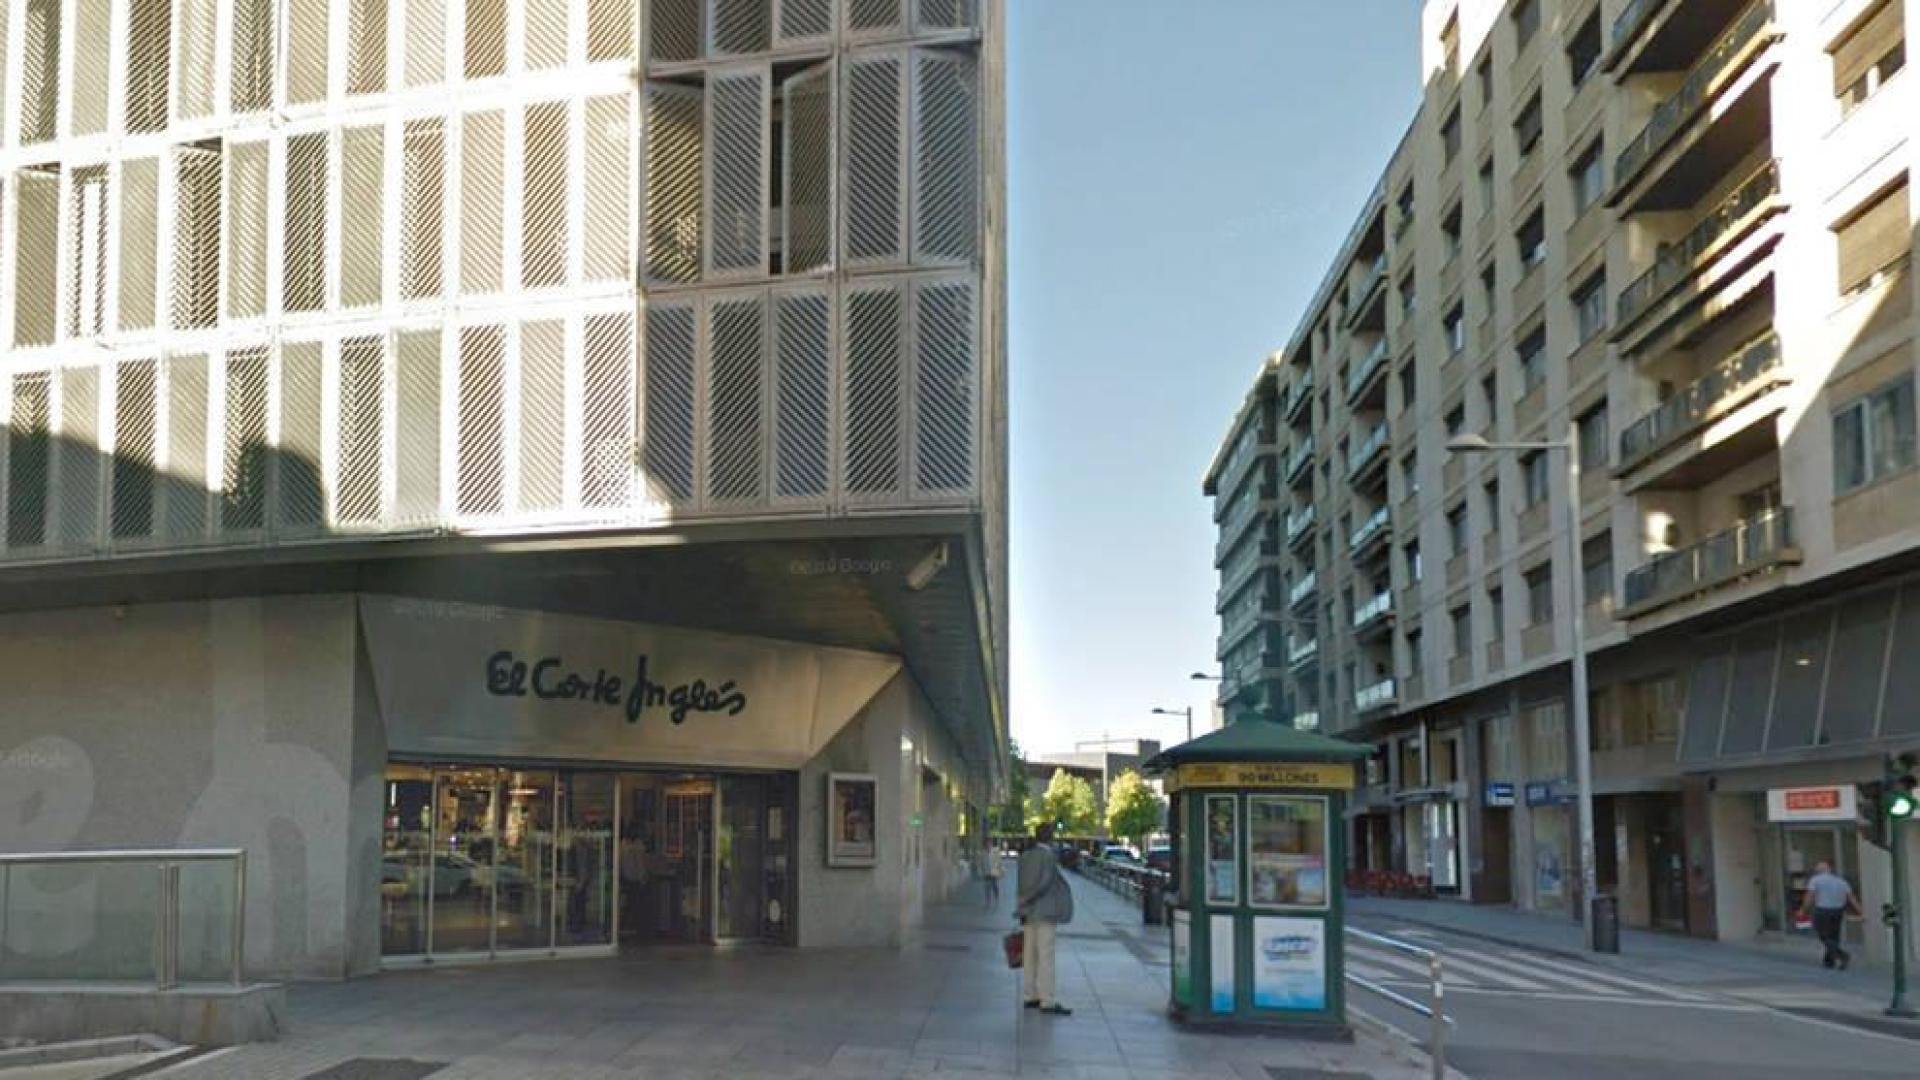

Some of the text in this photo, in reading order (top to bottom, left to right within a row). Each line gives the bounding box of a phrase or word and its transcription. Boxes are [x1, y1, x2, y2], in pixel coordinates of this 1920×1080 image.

[487, 650, 747, 725] El Corte Inglés
